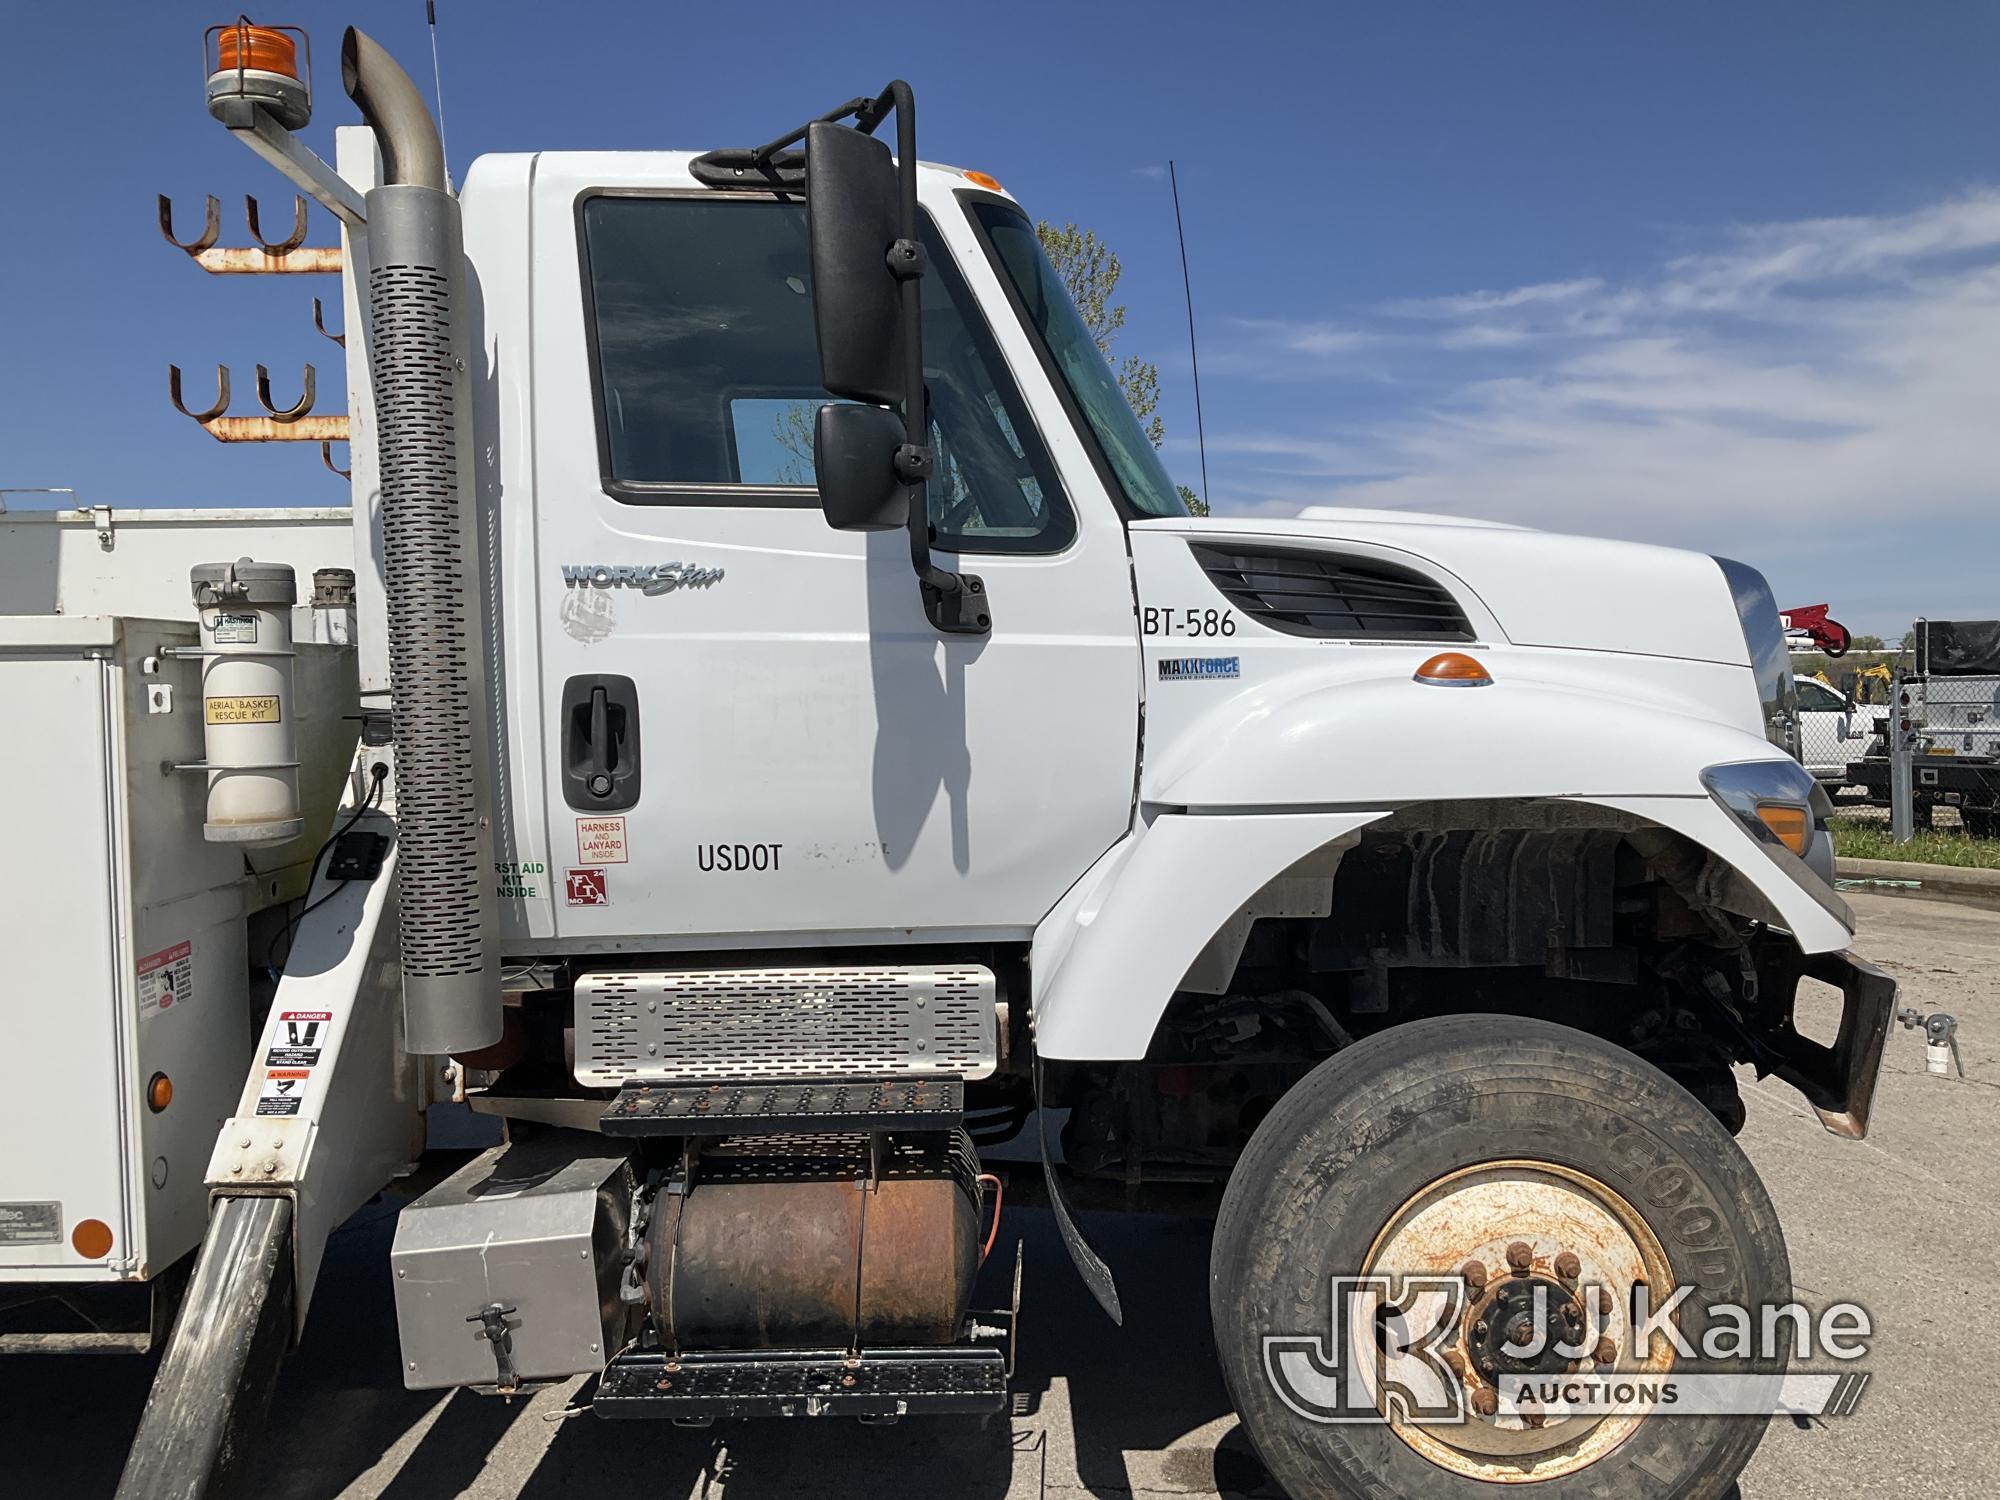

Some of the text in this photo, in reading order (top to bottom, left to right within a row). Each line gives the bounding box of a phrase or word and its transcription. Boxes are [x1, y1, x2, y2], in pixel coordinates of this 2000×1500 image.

[1143, 607, 1236, 637] BT-586
[1159, 656, 1239, 675] MAXXFORCE
[209, 699, 273, 710] AERIAL BASKET
[215, 711, 265, 720] RESCUE KIT
[581, 822, 621, 832] HARNESS
[594, 832, 610, 840] AND
[583, 840, 622, 851] LANYARD
[591, 850, 615, 859] INSIDE
[698, 844, 783, 871] USDOT
[522, 863, 544, 873] AID
[592, 870, 605, 878] 24
[502, 875, 524, 886] KIT
[496, 886, 536, 898] NSIDE
[295, 1012, 327, 1020] DANGER
